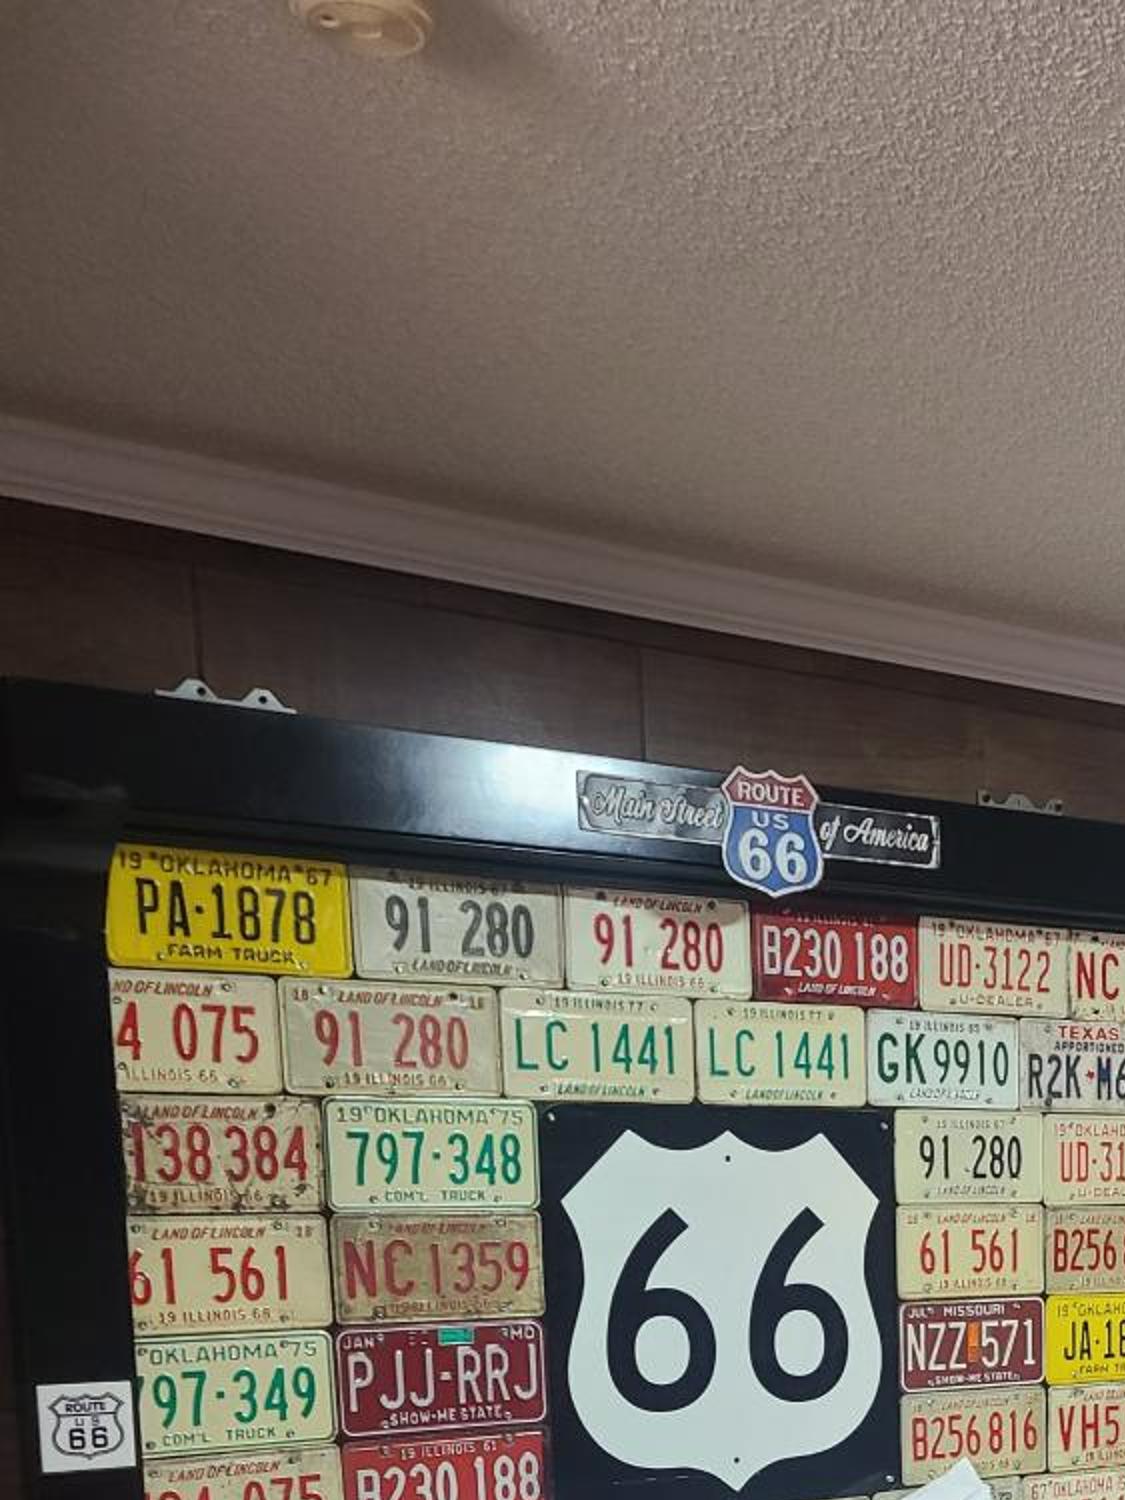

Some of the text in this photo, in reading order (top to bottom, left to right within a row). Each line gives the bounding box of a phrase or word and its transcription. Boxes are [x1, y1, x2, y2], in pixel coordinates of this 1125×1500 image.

[737, 781, 805, 806] ROUTE
[593, 784, 724, 829] Main Street
[752, 811, 790, 831] US
[819, 815, 930, 852] of America
[738, 829, 807, 884] 66
[160, 853, 291, 881] OKLAHOMA
[305, 869, 332, 886] 67
[385, 894, 534, 958] 91 280
[167, 943, 295, 964] FARM TRUCK
[593, 913, 723, 972] 91 280
[762, 925, 909, 983] B230 188
[153, 981, 213, 997] LINCOLN
[173, 1002, 259, 1064] 075
[314, 1009, 469, 1069] 91 280
[1058, 1025, 1119, 1041] TEXAS
[591, 1021, 675, 1075] 1441
[776, 1030, 849, 1080] 1441
[1054, 1042, 1125, 1054] APPORTIONED
[126, 1067, 192, 1082] ILLINOIS
[365, 1074, 424, 1086] ILLINOIS
[182, 1104, 200, 1119] OF
[202, 1105, 257, 1120] LINCOLN
[374, 1107, 488, 1124] OKLAHOMA
[225, 1125, 307, 1182] 384
[919, 1135, 1022, 1179] 91 280
[441, 1190, 485, 1201] TRUCK
[152, 1227, 265, 1240] LAND OF LINCOLN
[919, 1229, 1018, 1275] 61 561
[129, 1246, 288, 1305] 61 561
[343, 1239, 529, 1298] NC 1359
[183, 1309, 246, 1322] ILLINOIS
[607, 1207, 849, 1412] 66
[943, 1304, 1005, 1317] MISSOURI
[510, 1327, 535, 1340] MO
[151, 1343, 278, 1364] OKLAHOMA
[347, 1343, 538, 1413] PJJ-RRJ
[65, 1402, 106, 1412] ROUTE
[390, 1405, 501, 1427] SHOW-ME STATE
[69, 1427, 108, 1450] 66
[226, 1428, 276, 1441] TRUCK
[421, 1442, 476, 1458] ILLINOIS
